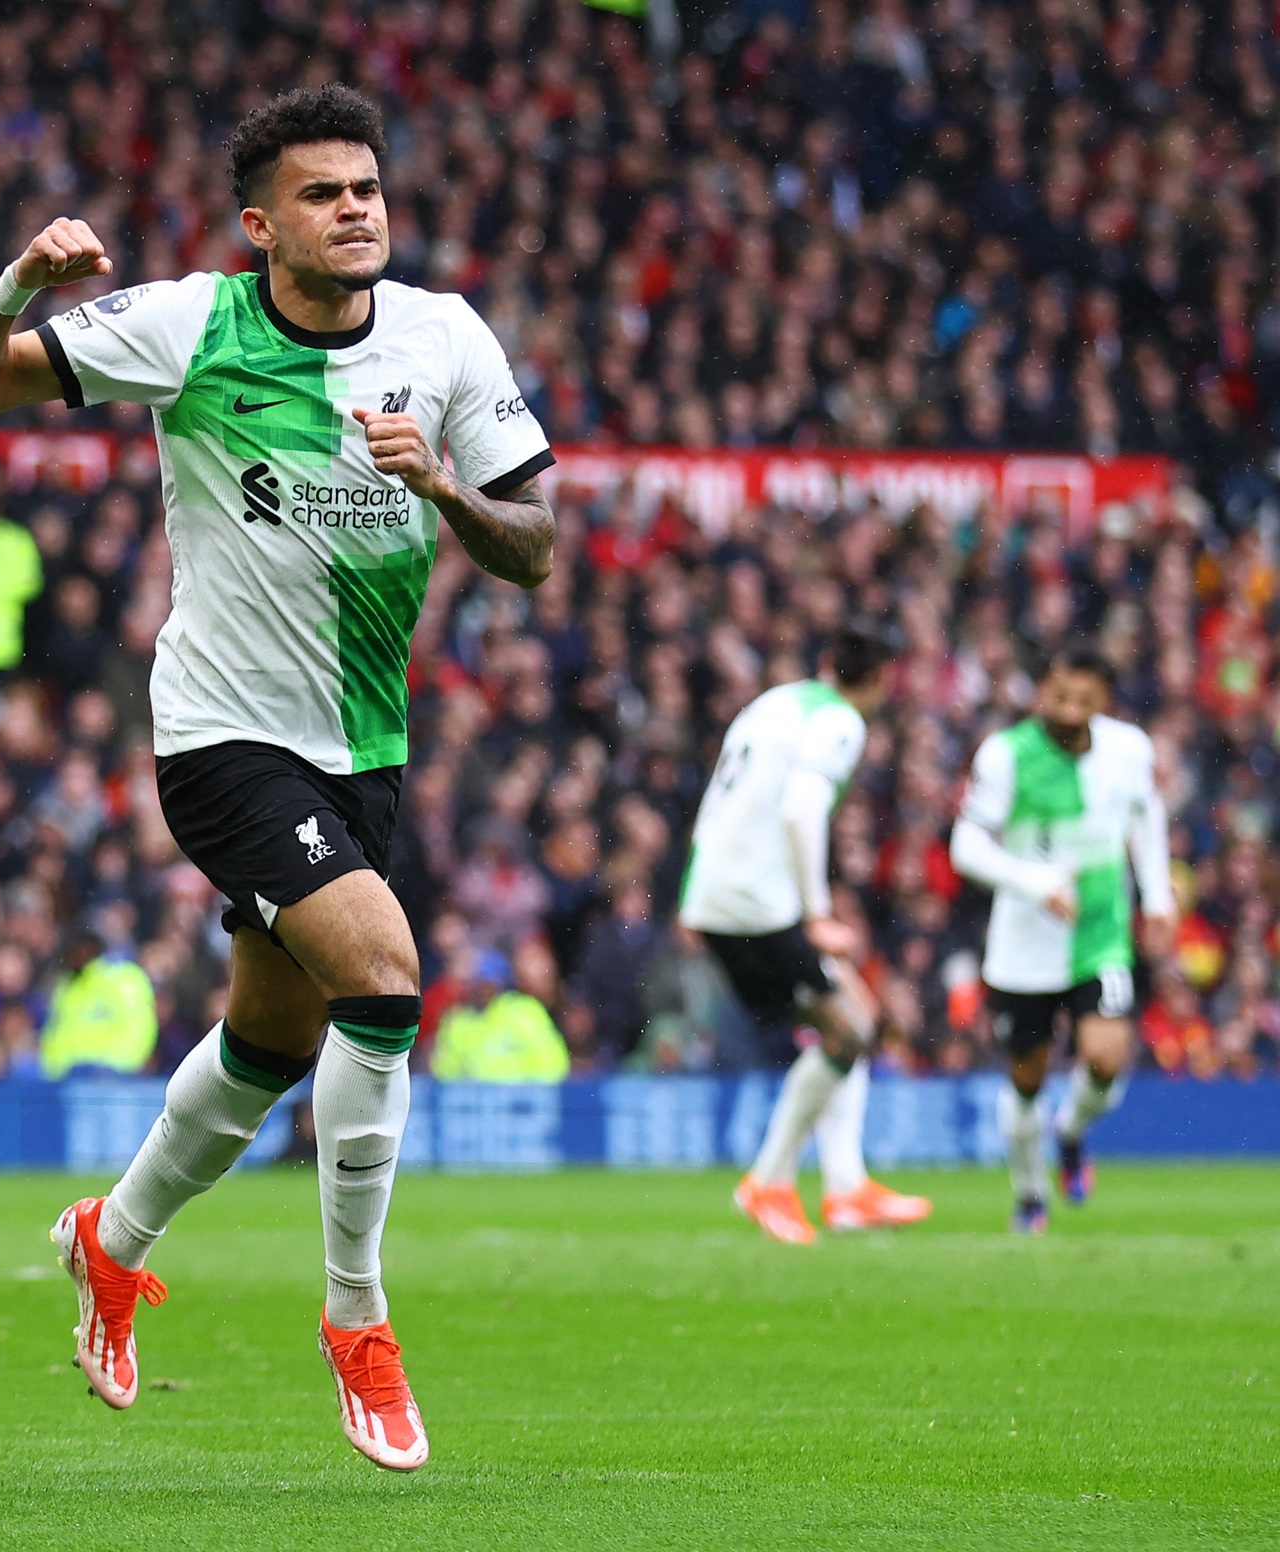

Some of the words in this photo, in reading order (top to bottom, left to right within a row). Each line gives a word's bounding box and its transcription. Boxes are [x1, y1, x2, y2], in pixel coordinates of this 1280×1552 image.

[292, 481, 407, 507] standard
[291, 504, 410, 529] chartered
[307, 845, 337, 865] L.F.C.
